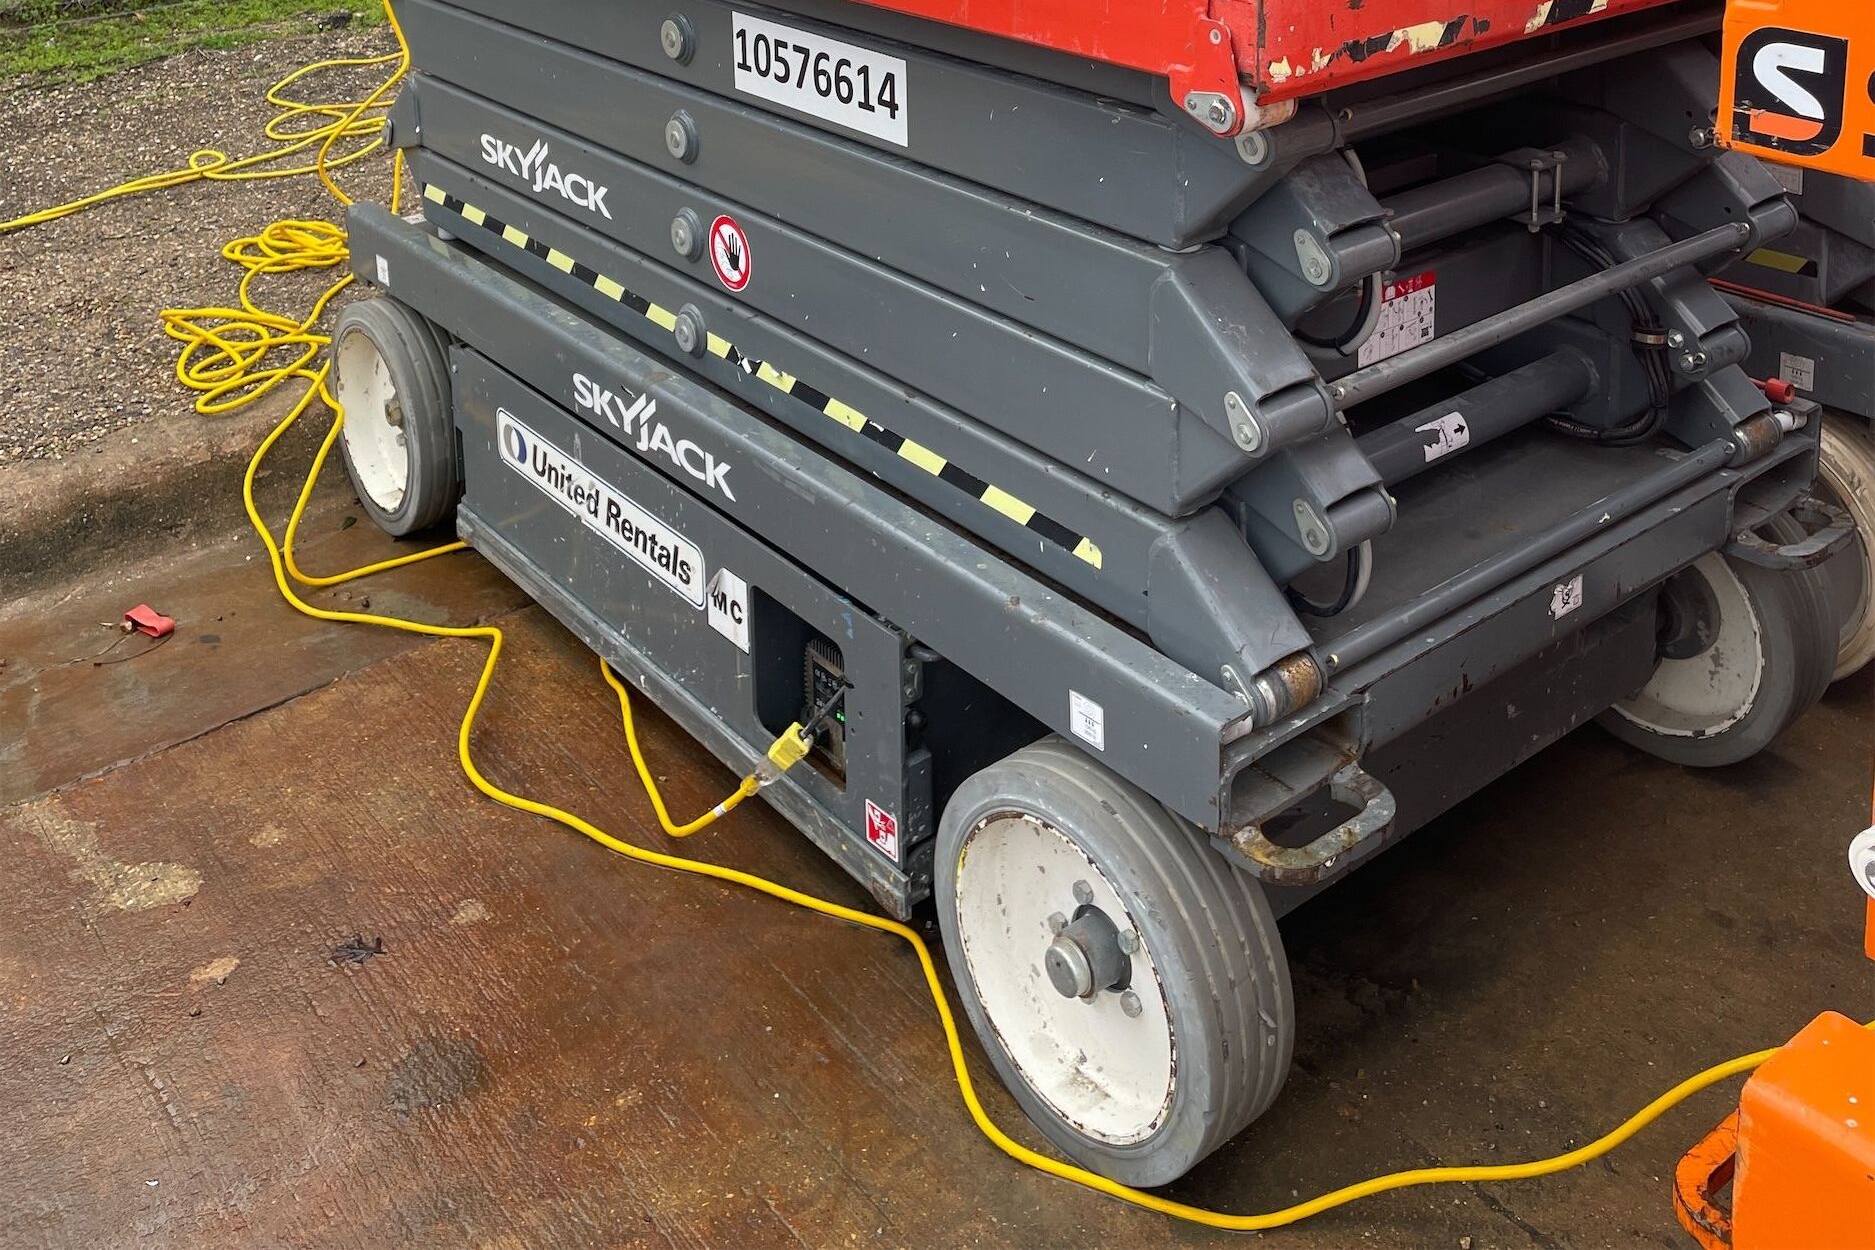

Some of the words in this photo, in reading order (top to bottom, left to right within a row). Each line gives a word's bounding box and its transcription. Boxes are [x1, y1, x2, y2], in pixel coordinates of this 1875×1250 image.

[735, 28, 899, 120] 10576614
[480, 133, 613, 221] SKYJACK
[572, 372, 736, 502] SKYJACK
[531, 444, 600, 519] United
[605, 496, 693, 586] Rentals
